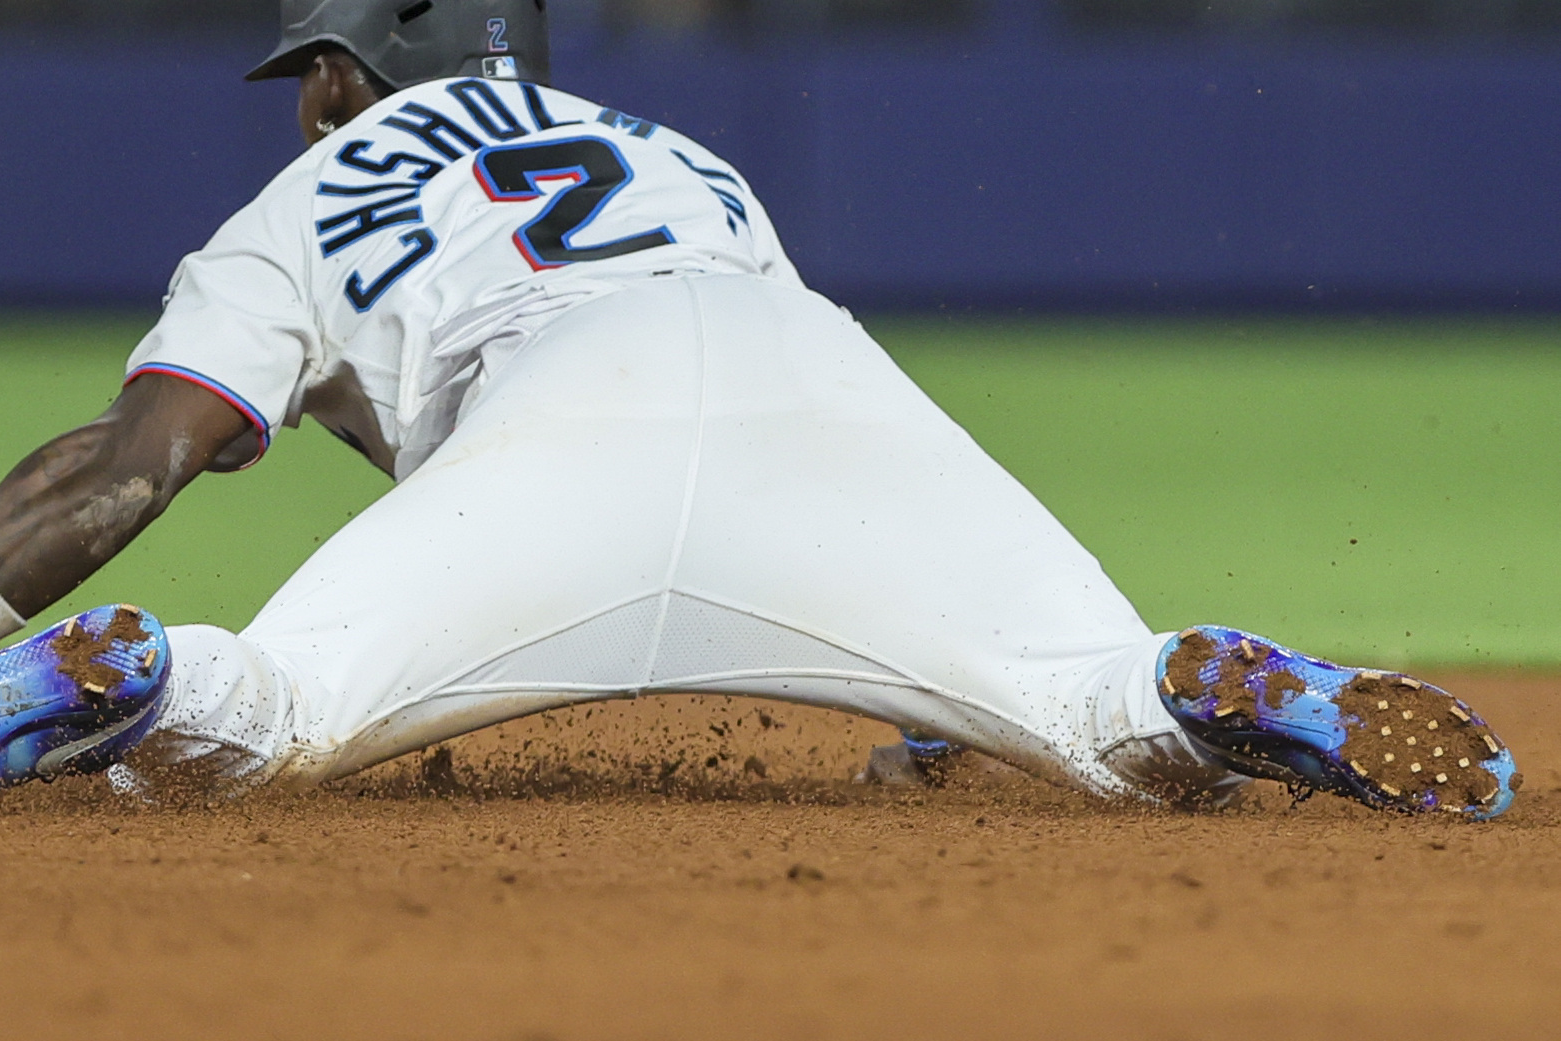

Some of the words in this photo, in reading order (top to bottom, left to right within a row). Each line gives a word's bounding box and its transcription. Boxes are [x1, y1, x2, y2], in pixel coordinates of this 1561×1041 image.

[486, 17, 509, 52] 2
[316, 77, 660, 313] CHISHOLM
[473, 134, 677, 272] 2
